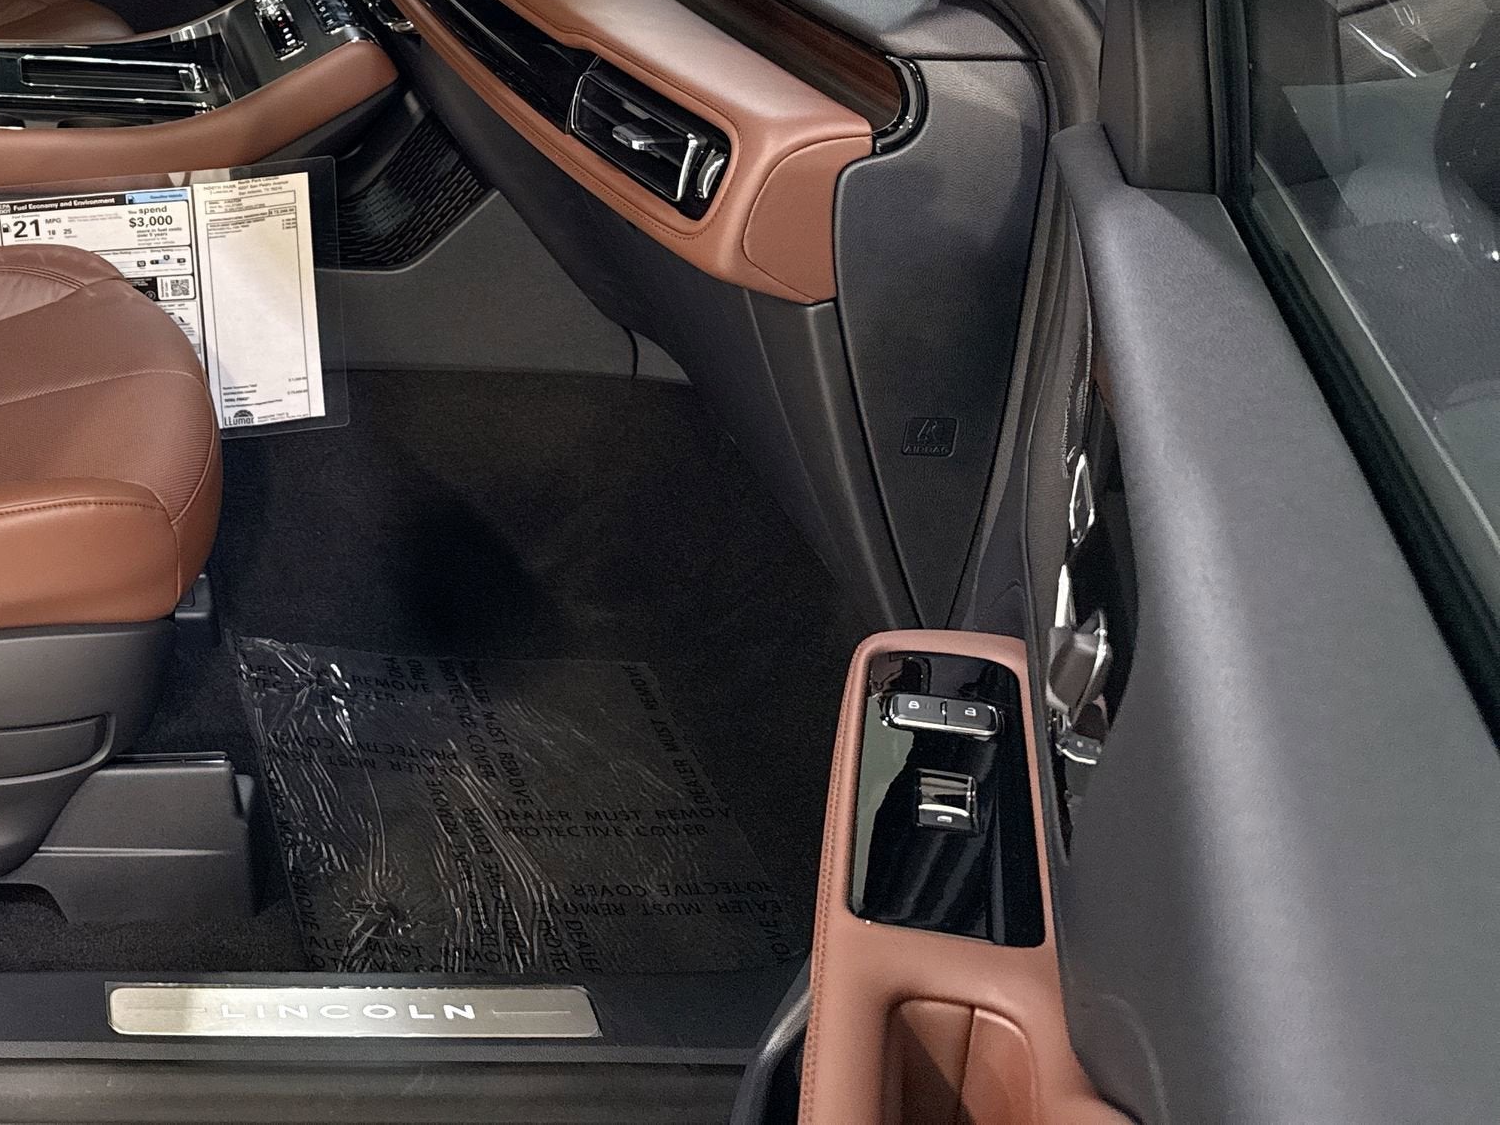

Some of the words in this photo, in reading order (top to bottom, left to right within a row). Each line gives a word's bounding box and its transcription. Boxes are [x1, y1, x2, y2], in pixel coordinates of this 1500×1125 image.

[28, 202, 58, 210] Economy
[73, 197, 116, 206] Environment
[138, 205, 168, 215] spend
[128, 215, 173, 228] $3,000
[13, 219, 40, 238] 21
[584, 809, 642, 822] MUST
[221, 1002, 476, 1021] LINCOLN
